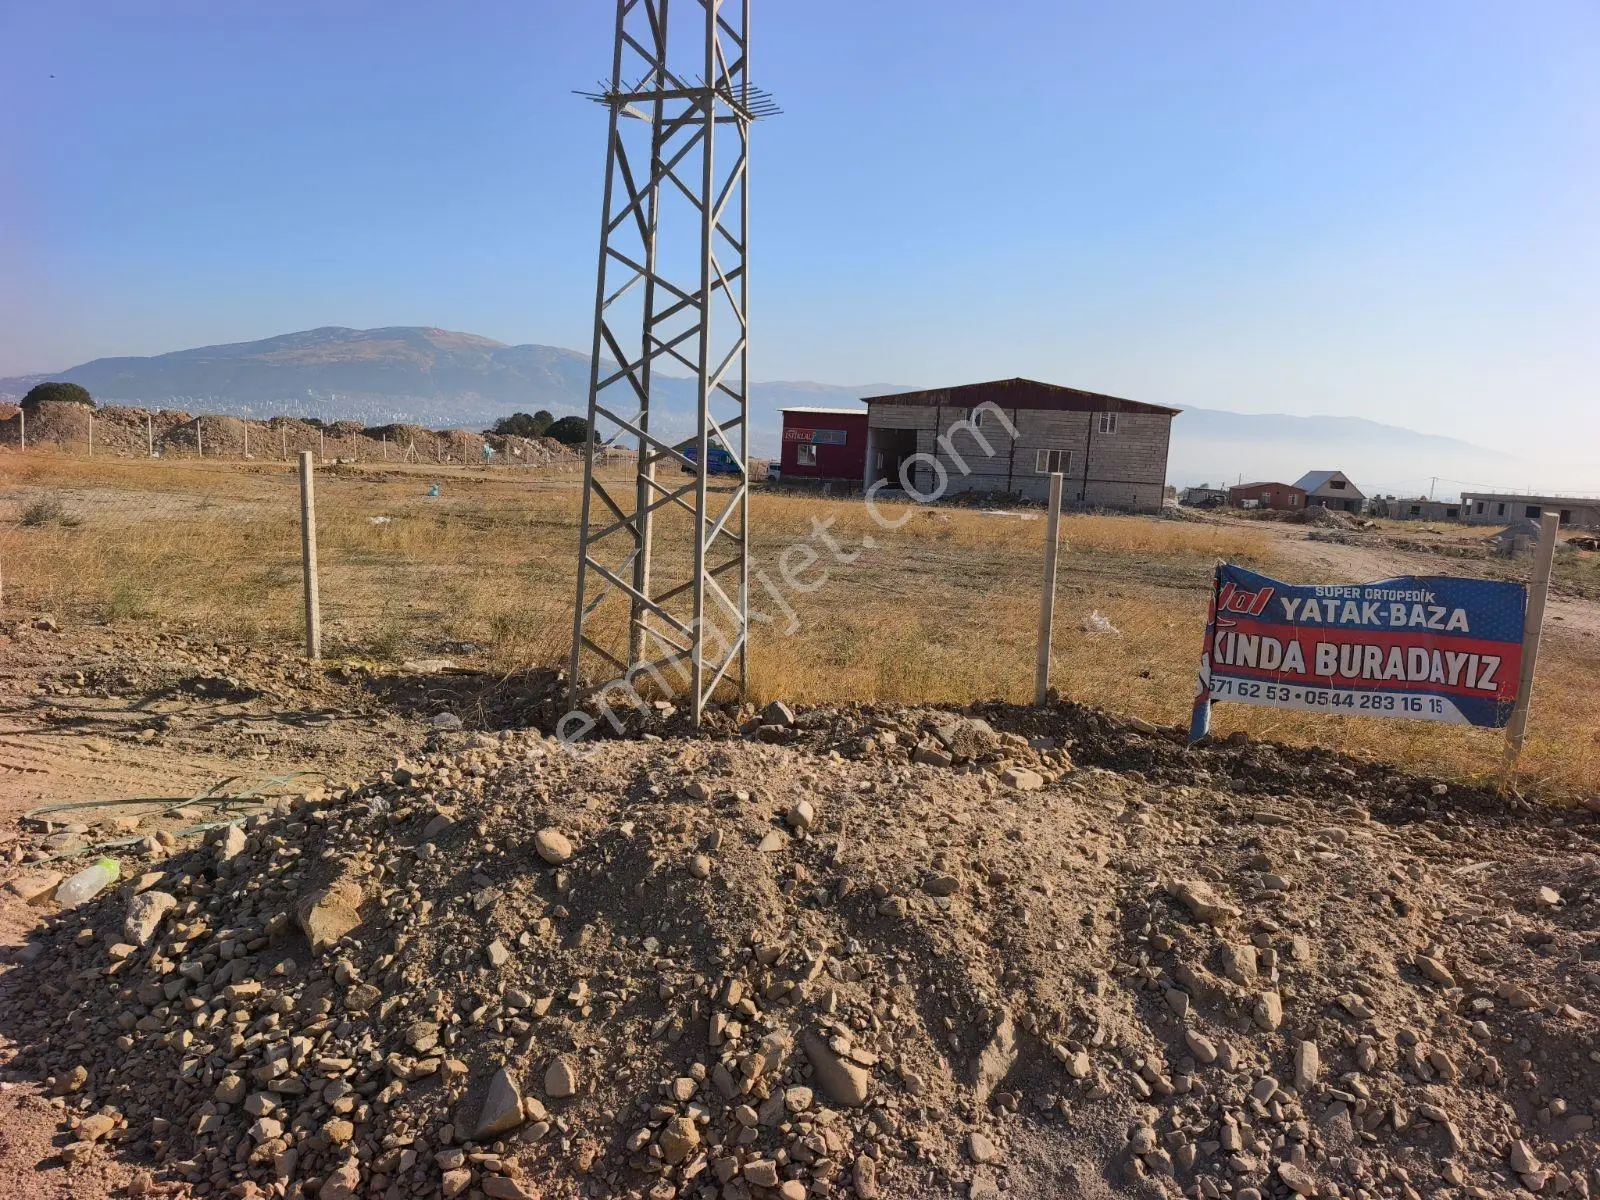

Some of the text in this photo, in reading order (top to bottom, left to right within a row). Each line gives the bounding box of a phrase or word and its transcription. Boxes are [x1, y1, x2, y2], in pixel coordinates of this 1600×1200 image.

[1365, 588, 1436, 603] ORTOPEDİK
[1280, 598, 1470, 632] YATAK-BAZA
[1315, 642, 1501, 691] BURADAYIZ
[1237, 682, 1260, 698] 62
[1266, 686, 1291, 702] 53
[1304, 690, 1354, 708] 0544
[1360, 695, 1395, 710] 283
[1401, 697, 1423, 712] 16
[1429, 699, 1443, 714] 15
